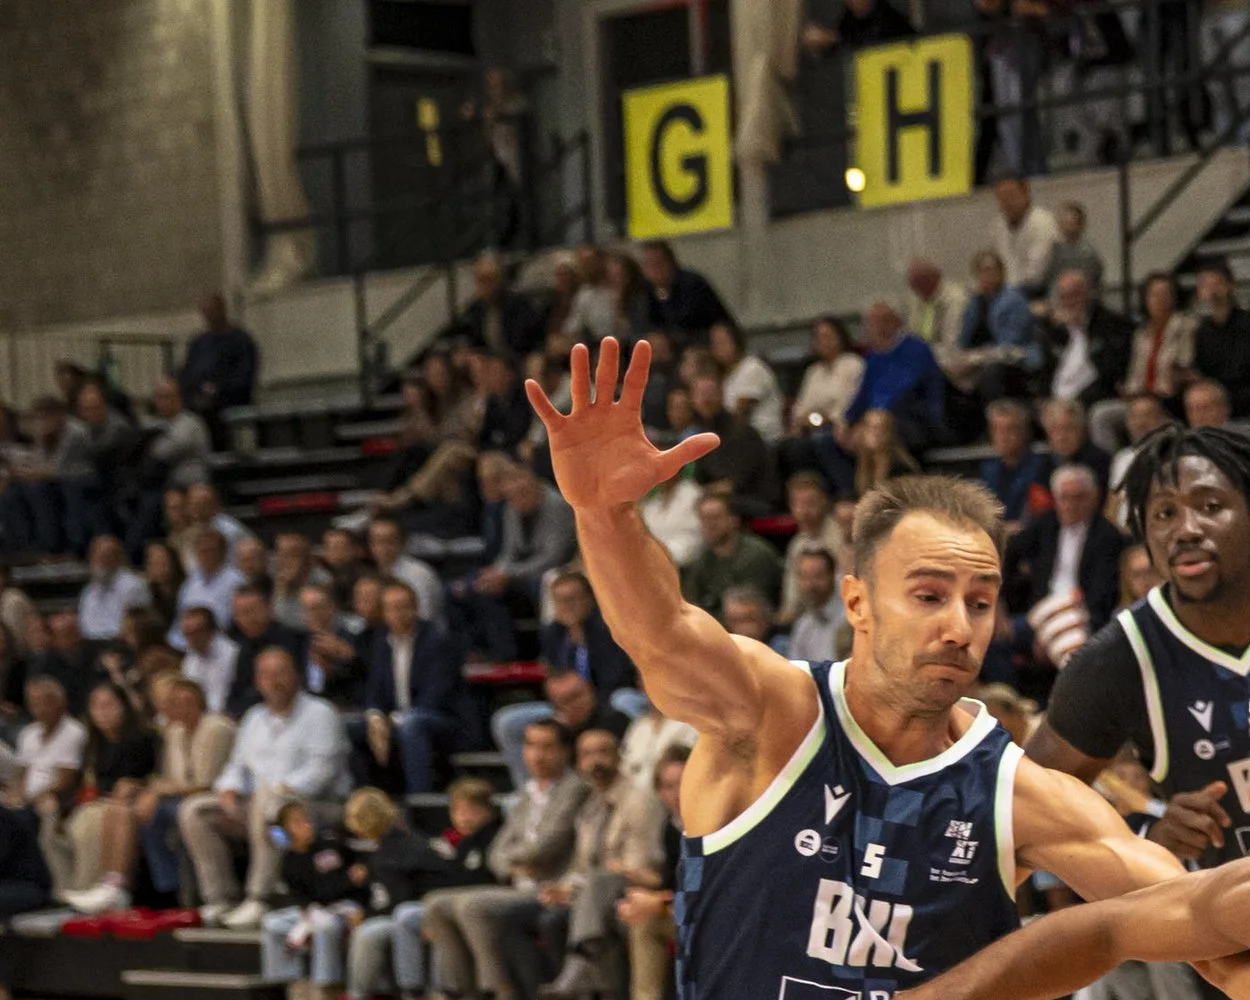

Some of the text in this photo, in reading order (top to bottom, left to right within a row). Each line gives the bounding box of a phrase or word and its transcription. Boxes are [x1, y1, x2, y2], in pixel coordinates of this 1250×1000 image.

[650, 103, 710, 216] G
[884, 59, 941, 186] H
[861, 843, 886, 879] 5
[806, 878, 925, 973] BXL
